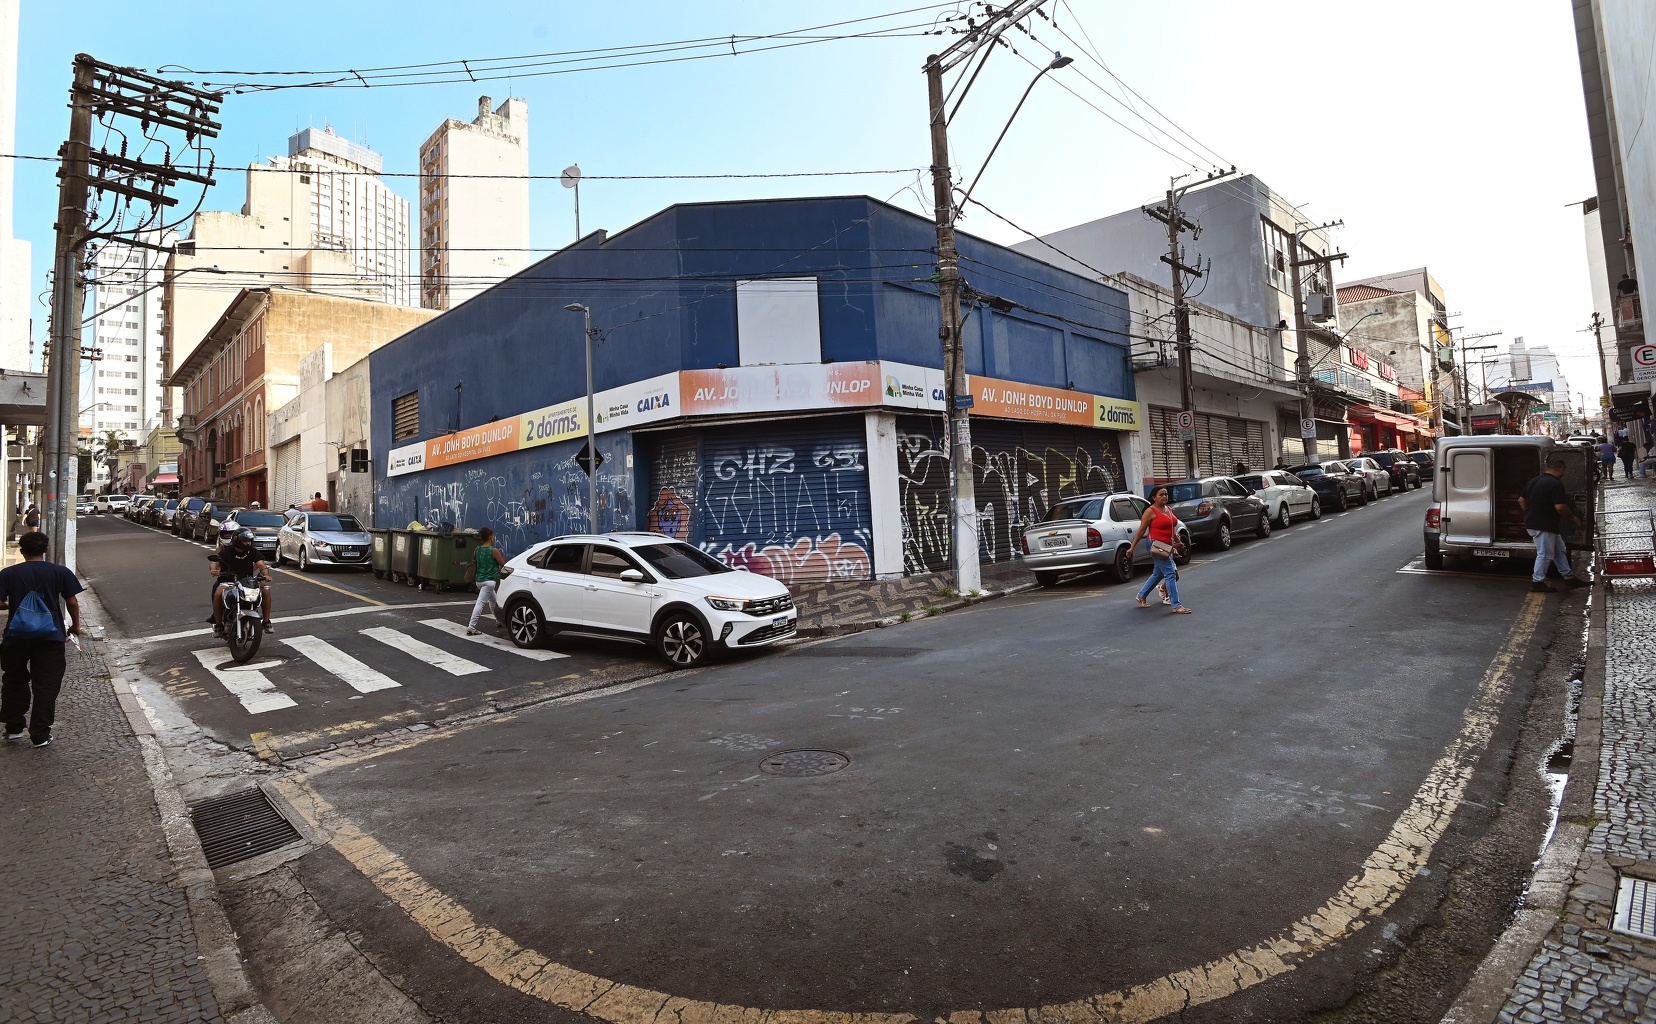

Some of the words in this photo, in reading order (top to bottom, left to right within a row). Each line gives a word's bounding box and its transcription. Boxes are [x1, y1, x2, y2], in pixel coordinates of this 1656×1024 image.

[1642, 349, 1654, 361] E
[694, 387, 716, 401] AV.
[981, 387, 997, 403] AV.
[1000, 390, 1026, 406] JONH
[1029, 394, 1053, 409] BOYD
[1055, 397, 1088, 414] DUNLOP
[637, 393, 670, 413] CAIXA
[1030, 410, 1050, 418] HOSPITAL
[1099, 405, 1106, 421] 2
[1107, 405, 1136, 425] dorms.
[1183, 416, 1188, 425] E
[526, 419, 534, 441] 2
[536, 414, 581, 438] dorms.
[432, 443, 442, 457] AV.
[443, 438, 460, 454] JONH
[461, 434, 480, 450] BOYD
[481, 425, 513, 445] DUNLOP
[408, 454, 422, 466] CAIXA
